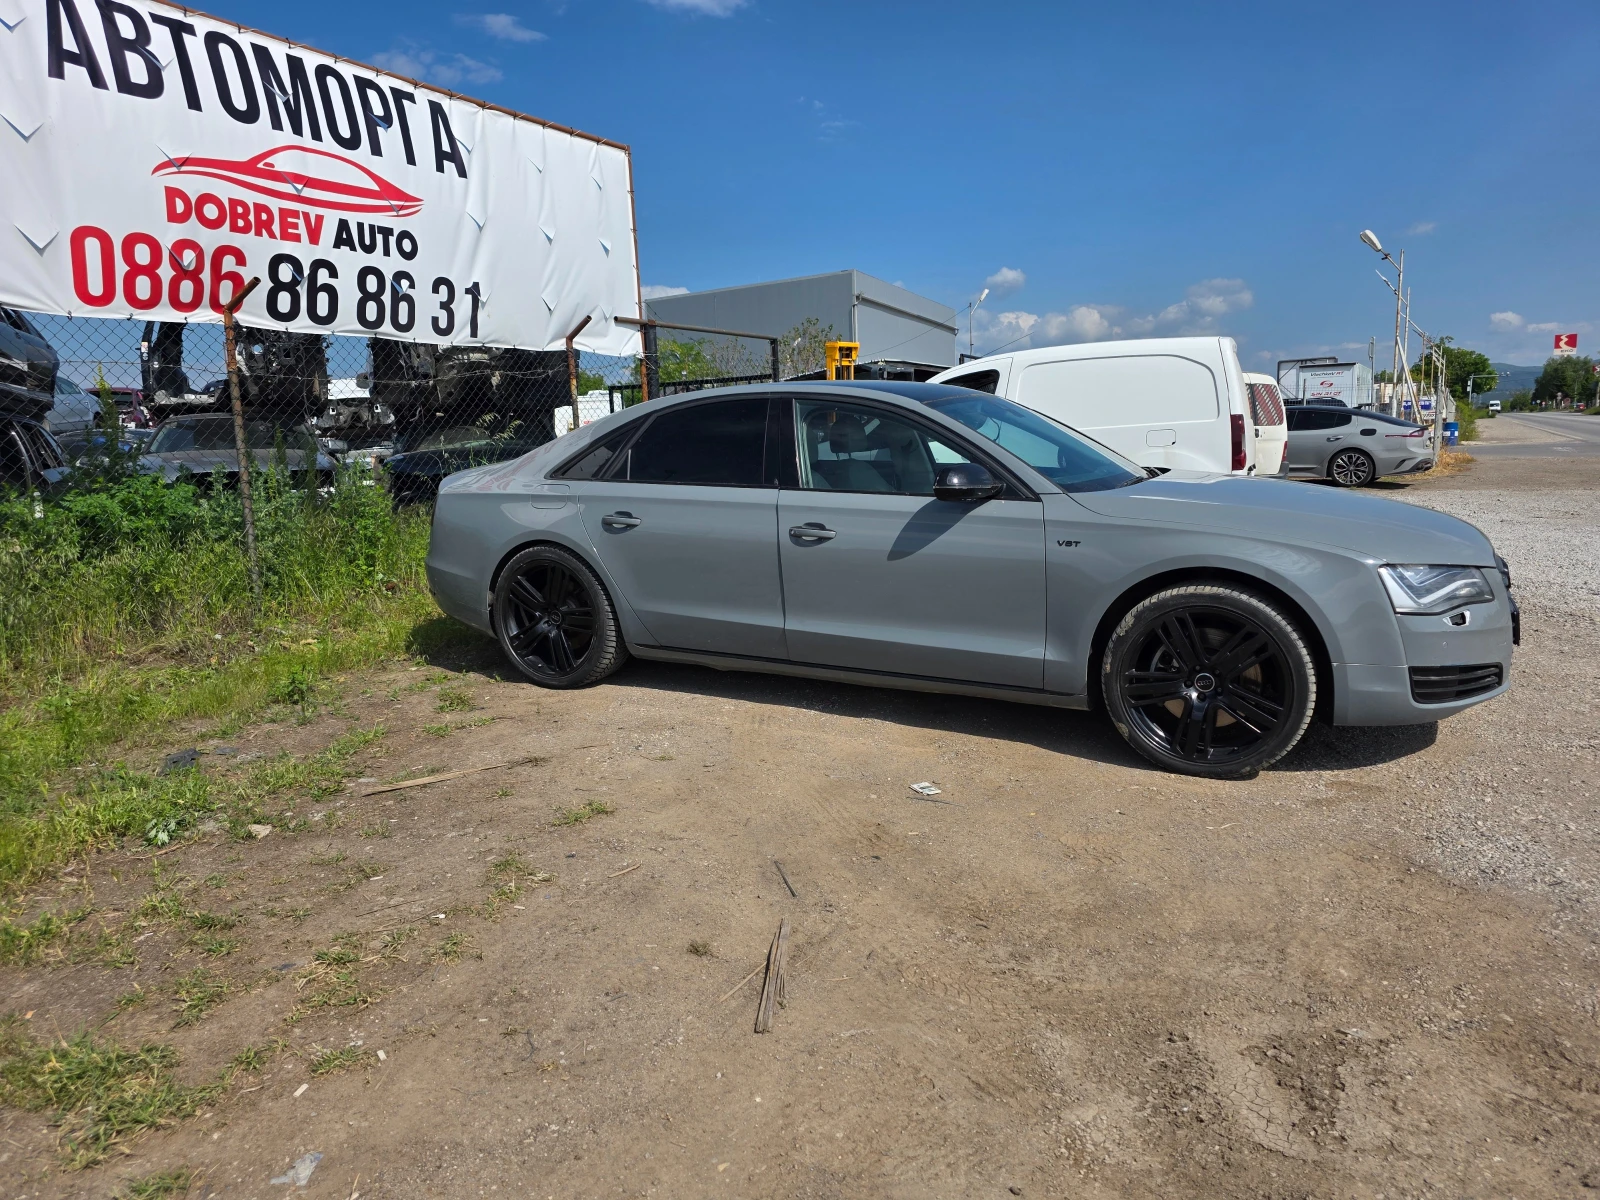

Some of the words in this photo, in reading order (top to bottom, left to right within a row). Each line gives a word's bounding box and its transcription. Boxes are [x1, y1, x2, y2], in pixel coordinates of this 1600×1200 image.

[46, 0, 468, 179] АВТОМОРГА
[164, 186, 324, 246] DOBREV
[332, 218, 419, 261] AUTO
[69, 225, 247, 315] 0886
[266, 253, 339, 326] 86
[356, 265, 416, 333] 86
[431, 276, 481, 339] 31
[1056, 540, 1081, 548] V8T
